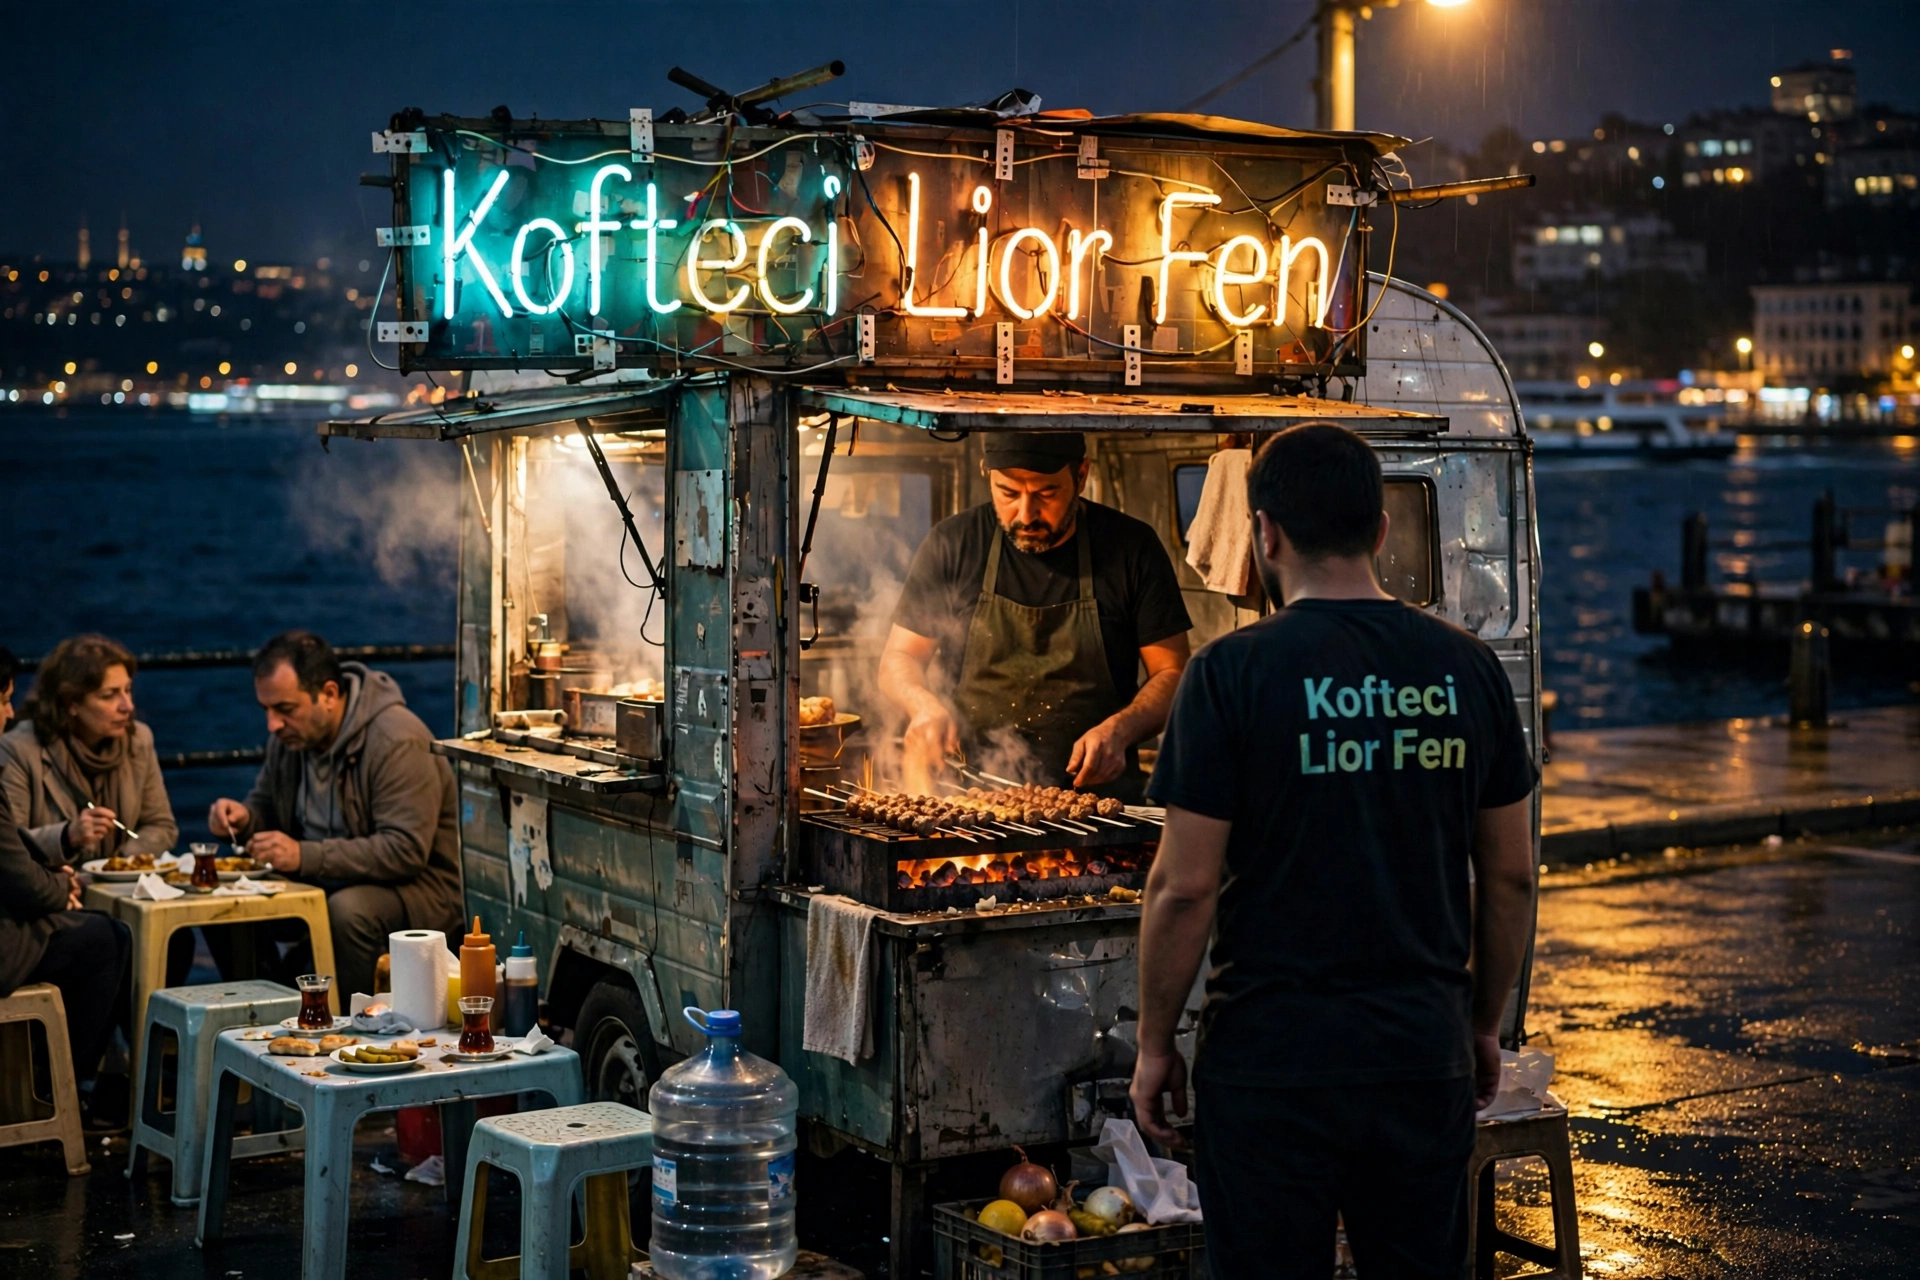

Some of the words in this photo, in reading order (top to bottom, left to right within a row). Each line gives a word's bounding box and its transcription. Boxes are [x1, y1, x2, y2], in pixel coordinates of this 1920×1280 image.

[443, 164, 839, 319] Kofteci
[901, 171, 1113, 320] Lior
[1154, 190, 1330, 328] Fen
[1303, 674, 1458, 720] Kofteci
[1299, 729, 1380, 774] Lior
[1393, 728, 1466, 770] Fen
